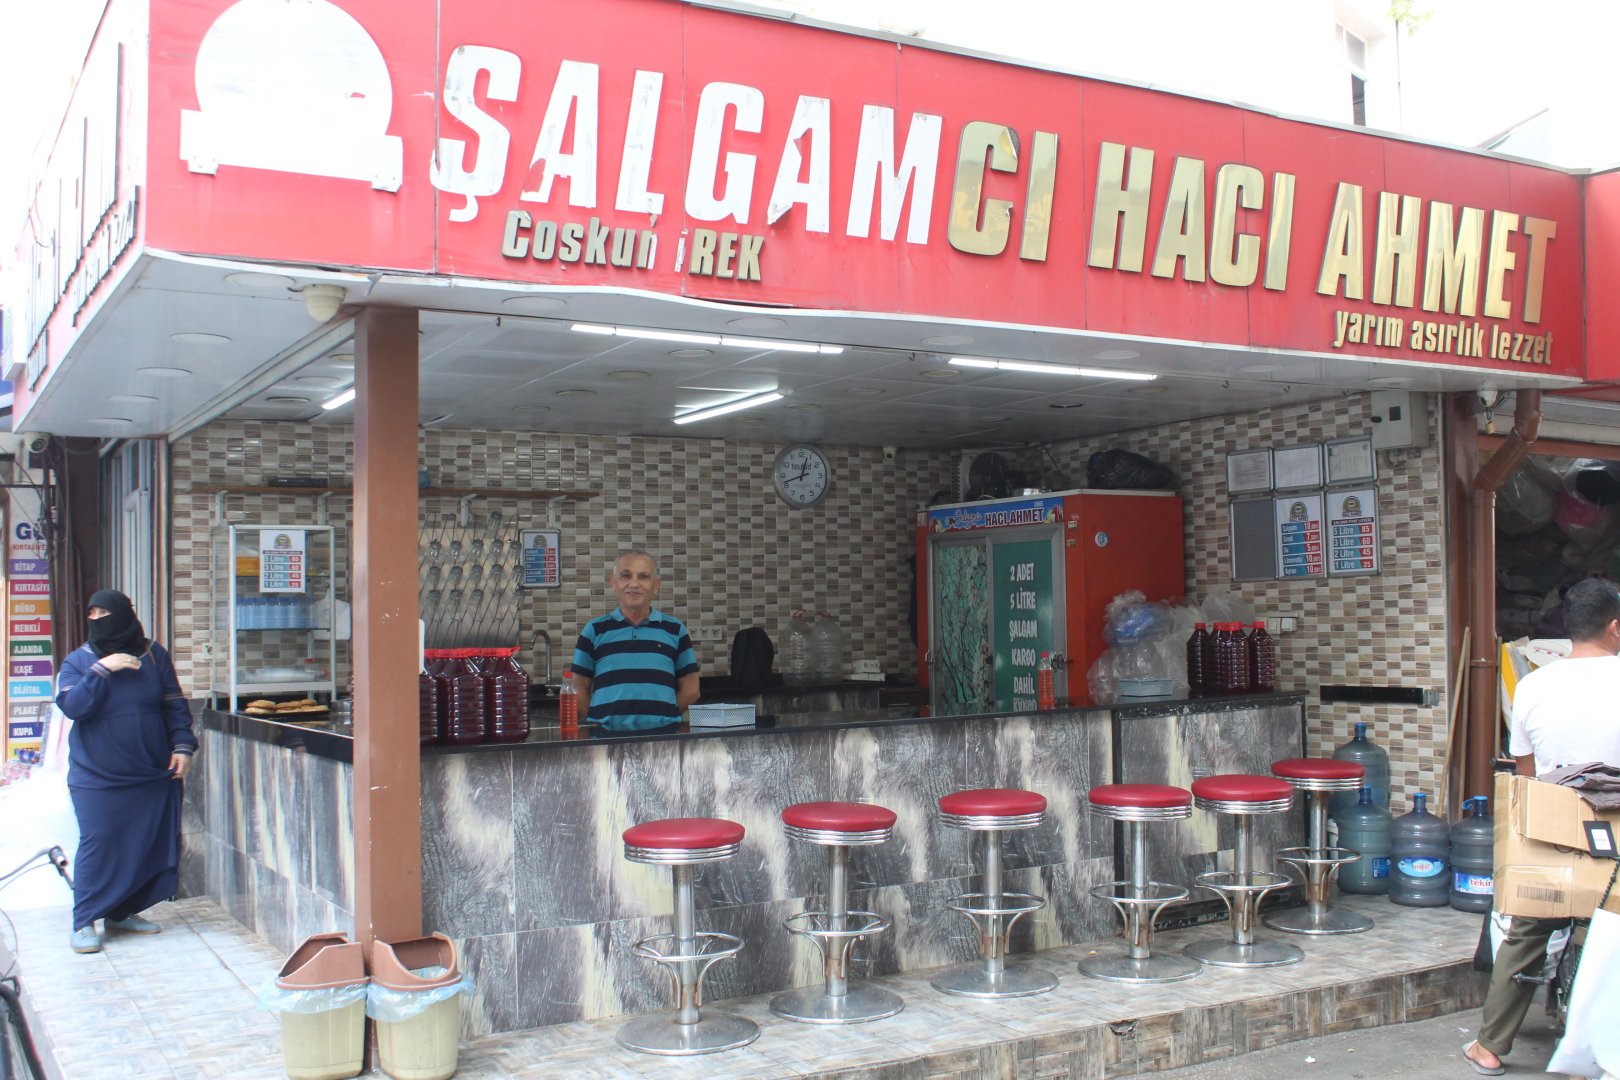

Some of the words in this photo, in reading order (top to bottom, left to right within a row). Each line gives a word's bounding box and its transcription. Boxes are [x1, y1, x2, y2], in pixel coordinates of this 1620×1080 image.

[429, 45, 1058, 261] ŞALGAMCI
[1087, 141, 1295, 291] HACI
[1316, 182, 1557, 324] AHMET
[1331, 310, 1403, 347] yarım
[1410, 320, 1484, 358] asırlık
[1489, 324, 1553, 365] lezzet
[985, 512, 1007, 527] HACI
[1010, 508, 1044, 525] AHMET
[1334, 527, 1338, 535] 5
[1339, 526, 1354, 534] Litre
[1334, 538, 1338, 546] 3
[1339, 538, 1354, 546] Litre
[1363, 537, 1370, 545] 60
[1334, 549, 1339, 557] 2
[1340, 549, 1354, 557] Litre
[14, 561, 36, 572] KİTAP
[1335, 561, 1339, 569] 1
[1341, 560, 1355, 568] Litre
[1010, 565, 1015, 582] 2
[1016, 562, 1035, 581] ADET
[1010, 593, 1015, 609] 5
[1016, 588, 1036, 609] LİTRE
[14, 603, 35, 613] BÜRO
[14, 622, 40, 633] RENKLİ
[1009, 619, 1038, 642] ŞALGAM
[14, 645, 43, 654] AJANDA
[1011, 648, 1036, 666] KARGO
[14, 665, 33, 675] KAŞE
[1014, 673, 1035, 694] DAHİL
[13, 685, 41, 694] DİJİTAL
[13, 727, 33, 736] KUPA
[1469, 878, 1492, 887] tekir
